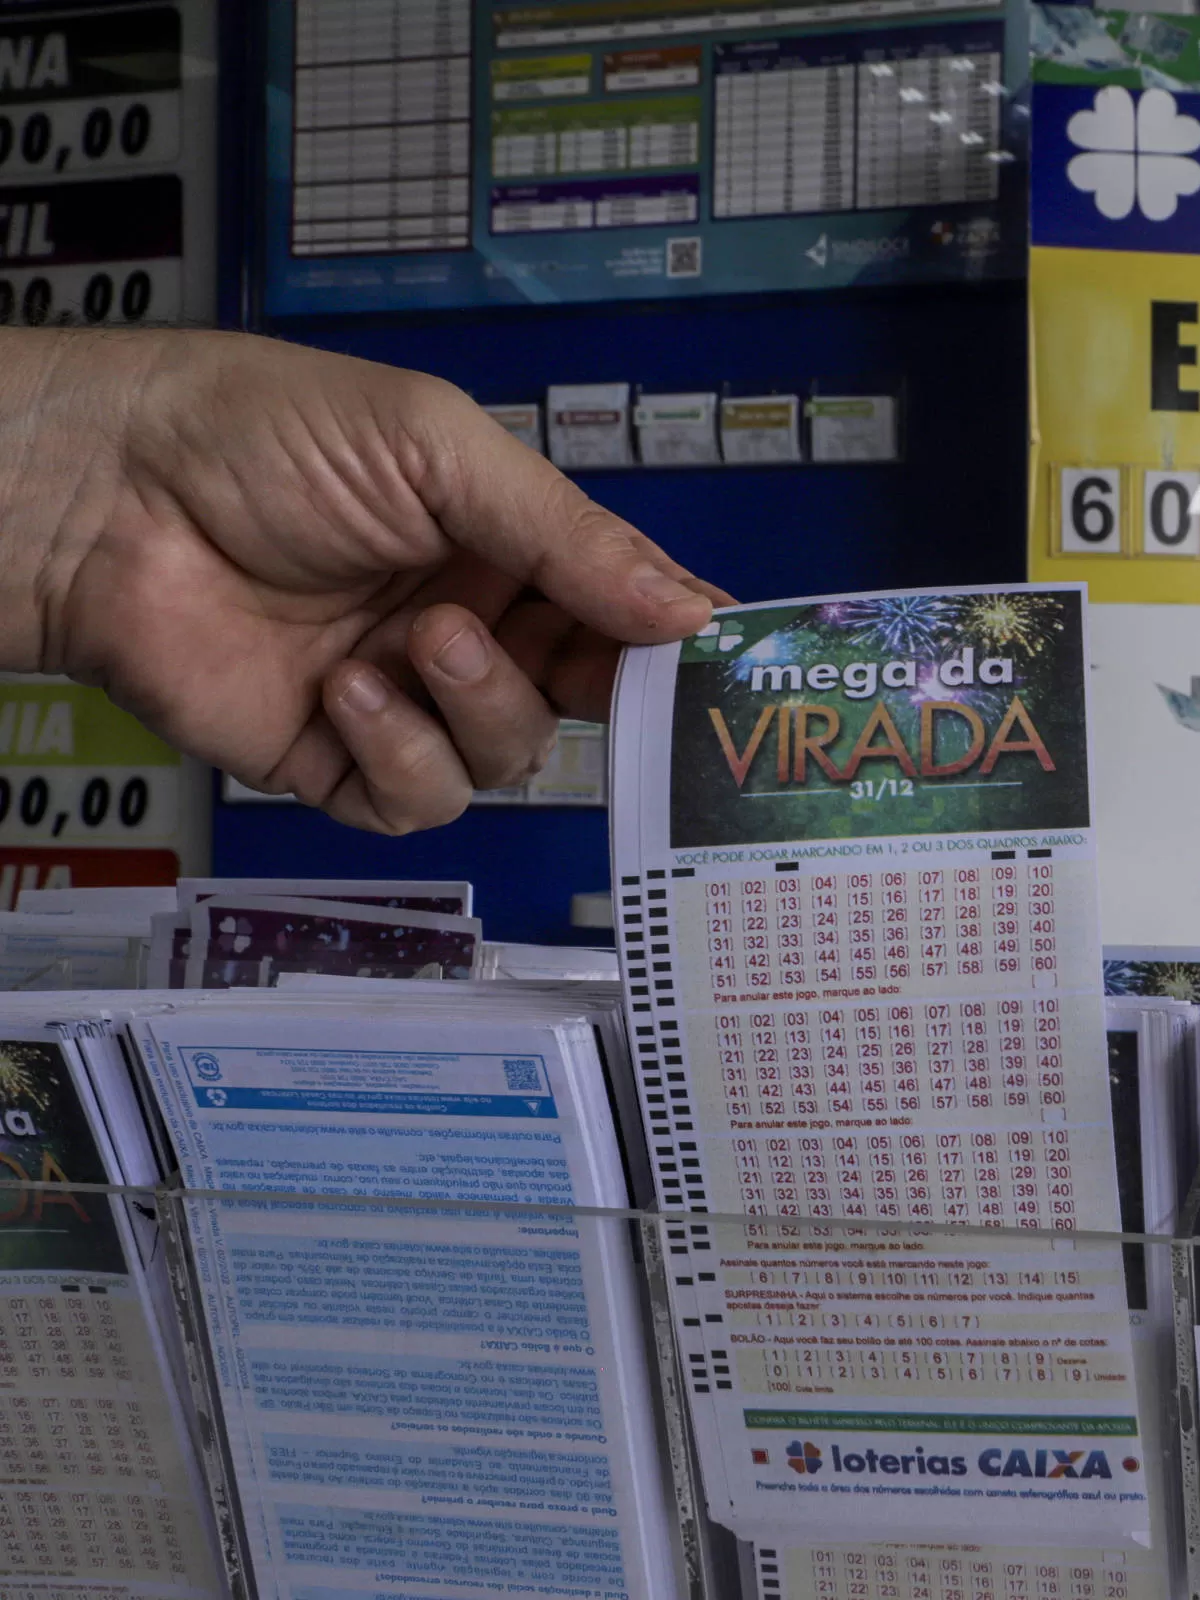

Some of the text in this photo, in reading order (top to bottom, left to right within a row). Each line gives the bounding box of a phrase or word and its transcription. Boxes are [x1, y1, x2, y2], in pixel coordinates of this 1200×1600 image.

[751, 647, 1012, 699] mega da
[708, 695, 1056, 788] VIRADA
[850, 779, 914, 799] 31/12
[675, 851, 709, 864] VOCÊ
[712, 852, 744, 863] PODE
[748, 849, 788, 861] JOGAR
[792, 844, 862, 858] MARCANDO
[866, 844, 883, 855] EM
[902, 843, 907, 853] 2
[912, 841, 932, 853] OU
[936, 840, 943, 850] 3
[948, 839, 974, 850] DOS
[976, 836, 1037, 849] QUADROS
[1041, 834, 1087, 846] ABAIXO:
[714, 993, 736, 1003] Para
[740, 992, 769, 1002] anular
[773, 991, 794, 1000] este
[823, 988, 860, 998] marque
[863, 987, 875, 995] ao
[720, 1258, 757, 1267] Assinale
[761, 1259, 796, 1268] quantos
[725, 1289, 797, 1299] SURPRESINHA
[805, 1291, 825, 1300] Aqui
[731, 1333, 765, 1343] BOLÃO
[916, 1338, 932, 1346] 100
[831, 1444, 1112, 1479] loterias CAIXA
